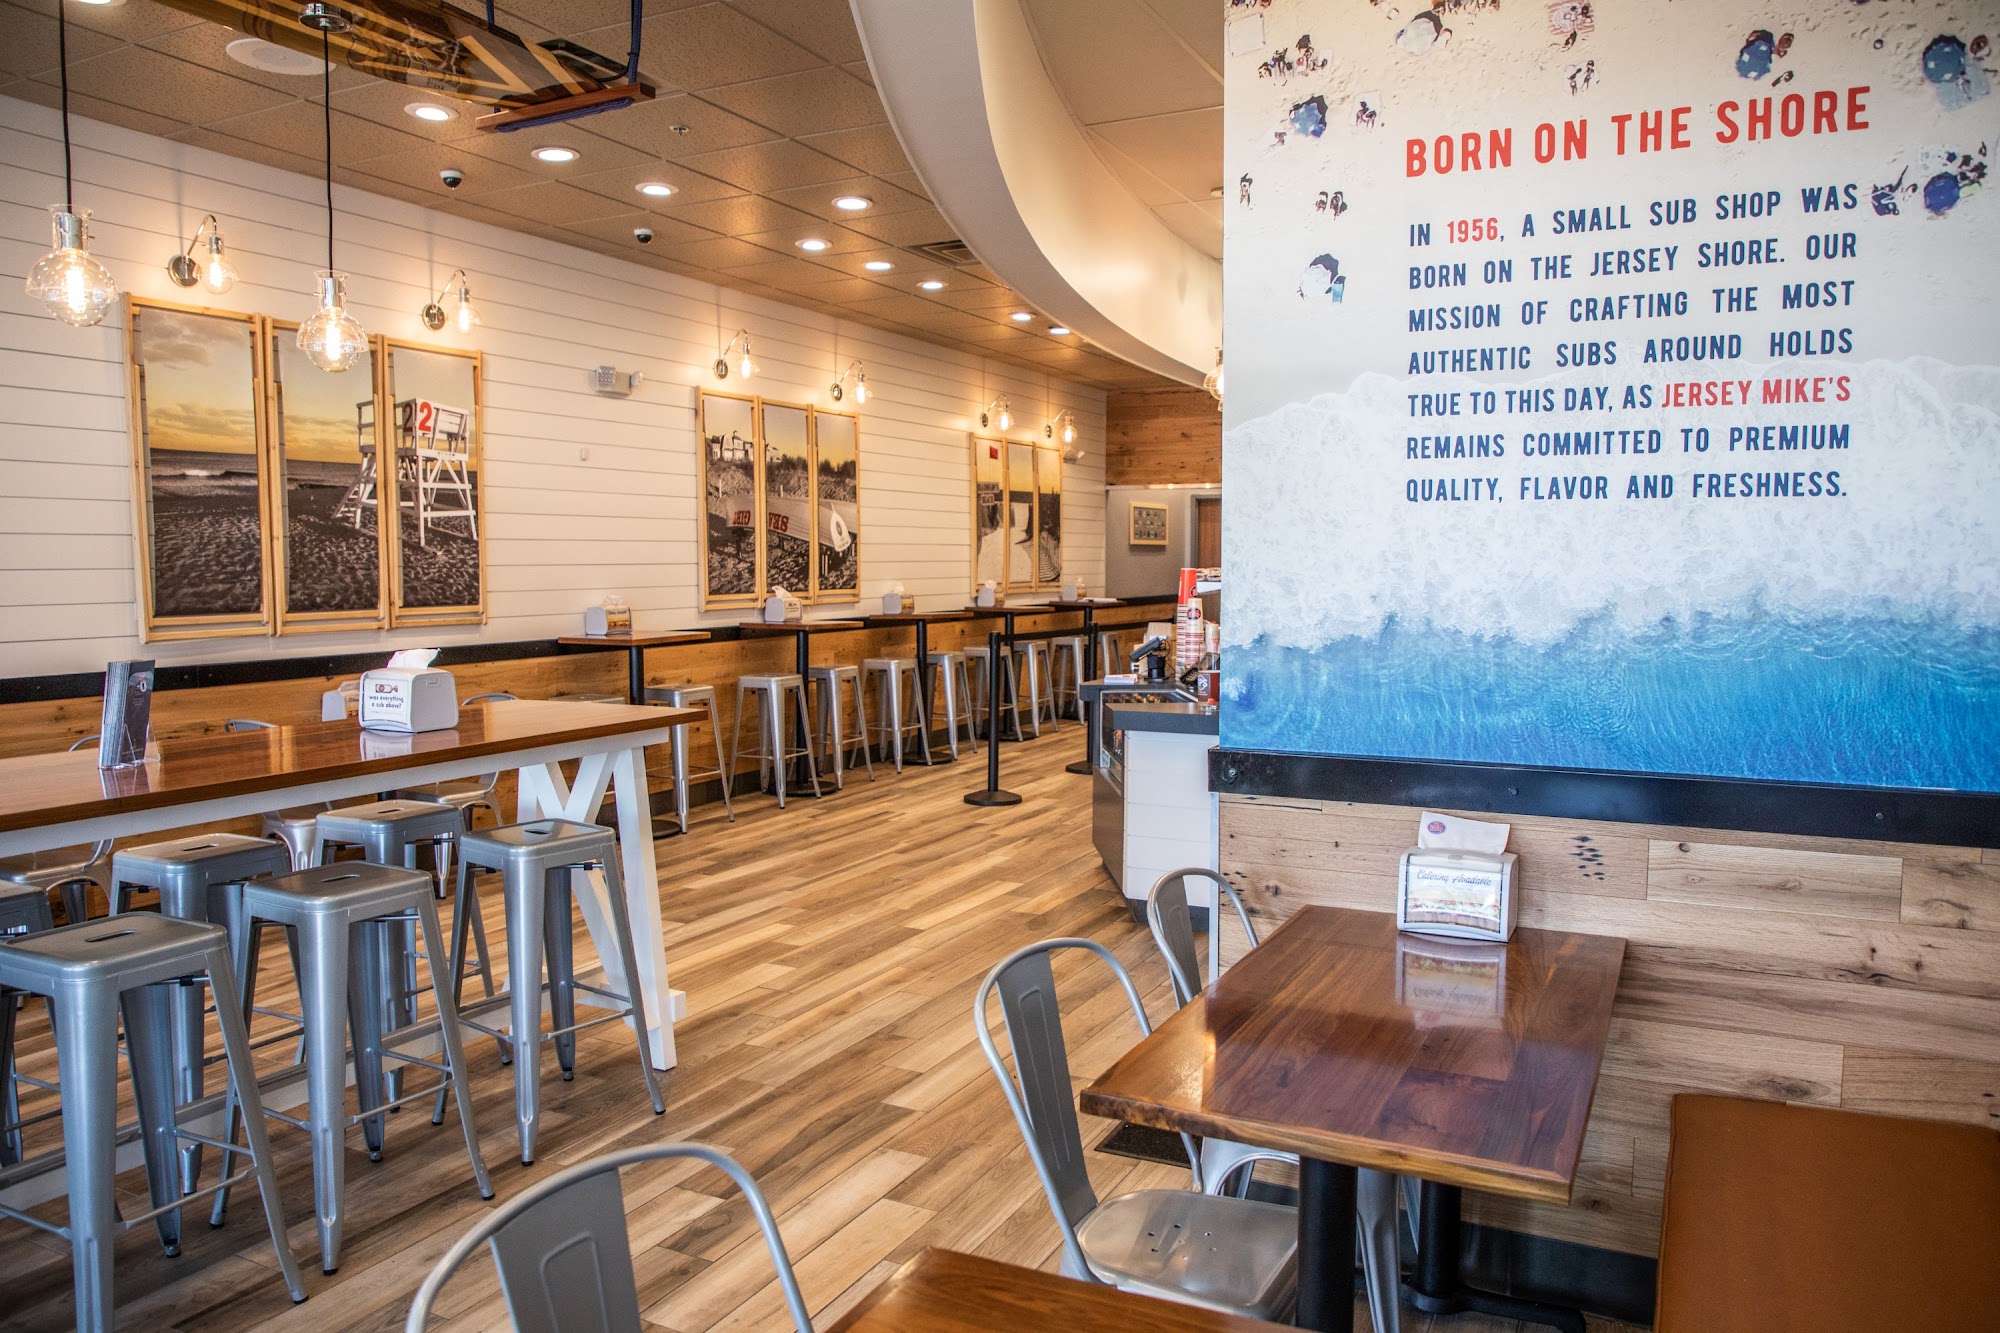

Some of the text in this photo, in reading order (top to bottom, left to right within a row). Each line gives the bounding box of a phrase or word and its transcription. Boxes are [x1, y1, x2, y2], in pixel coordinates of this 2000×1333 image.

[1406, 86, 1870, 178] BORN ON THE SHORE
[1411, 184, 1857, 245] IN 1956, A SMALL SUB SHOP WAS
[1410, 233, 1856, 289] BORN ON THE JERSEY SHORE. OUR
[1410, 280, 1854, 331] MISSION OF CRAFTING THE MOST
[1410, 328, 1852, 373] AUTHENTIC SUBS AROUND HOLDS
[1410, 376, 1850, 416] TRUE TO THIS DAY, AS JERSEY MIKE'S
[403, 402, 413, 432] 2
[418, 401, 433, 432] 2
[1407, 424, 1849, 458] REMAINS COMMITTED TO PREMIUM
[1407, 471, 1846, 502] QUALITY, FLAVOR AND FRESHNESS.
[1416, 869, 1450, 884] Catering
